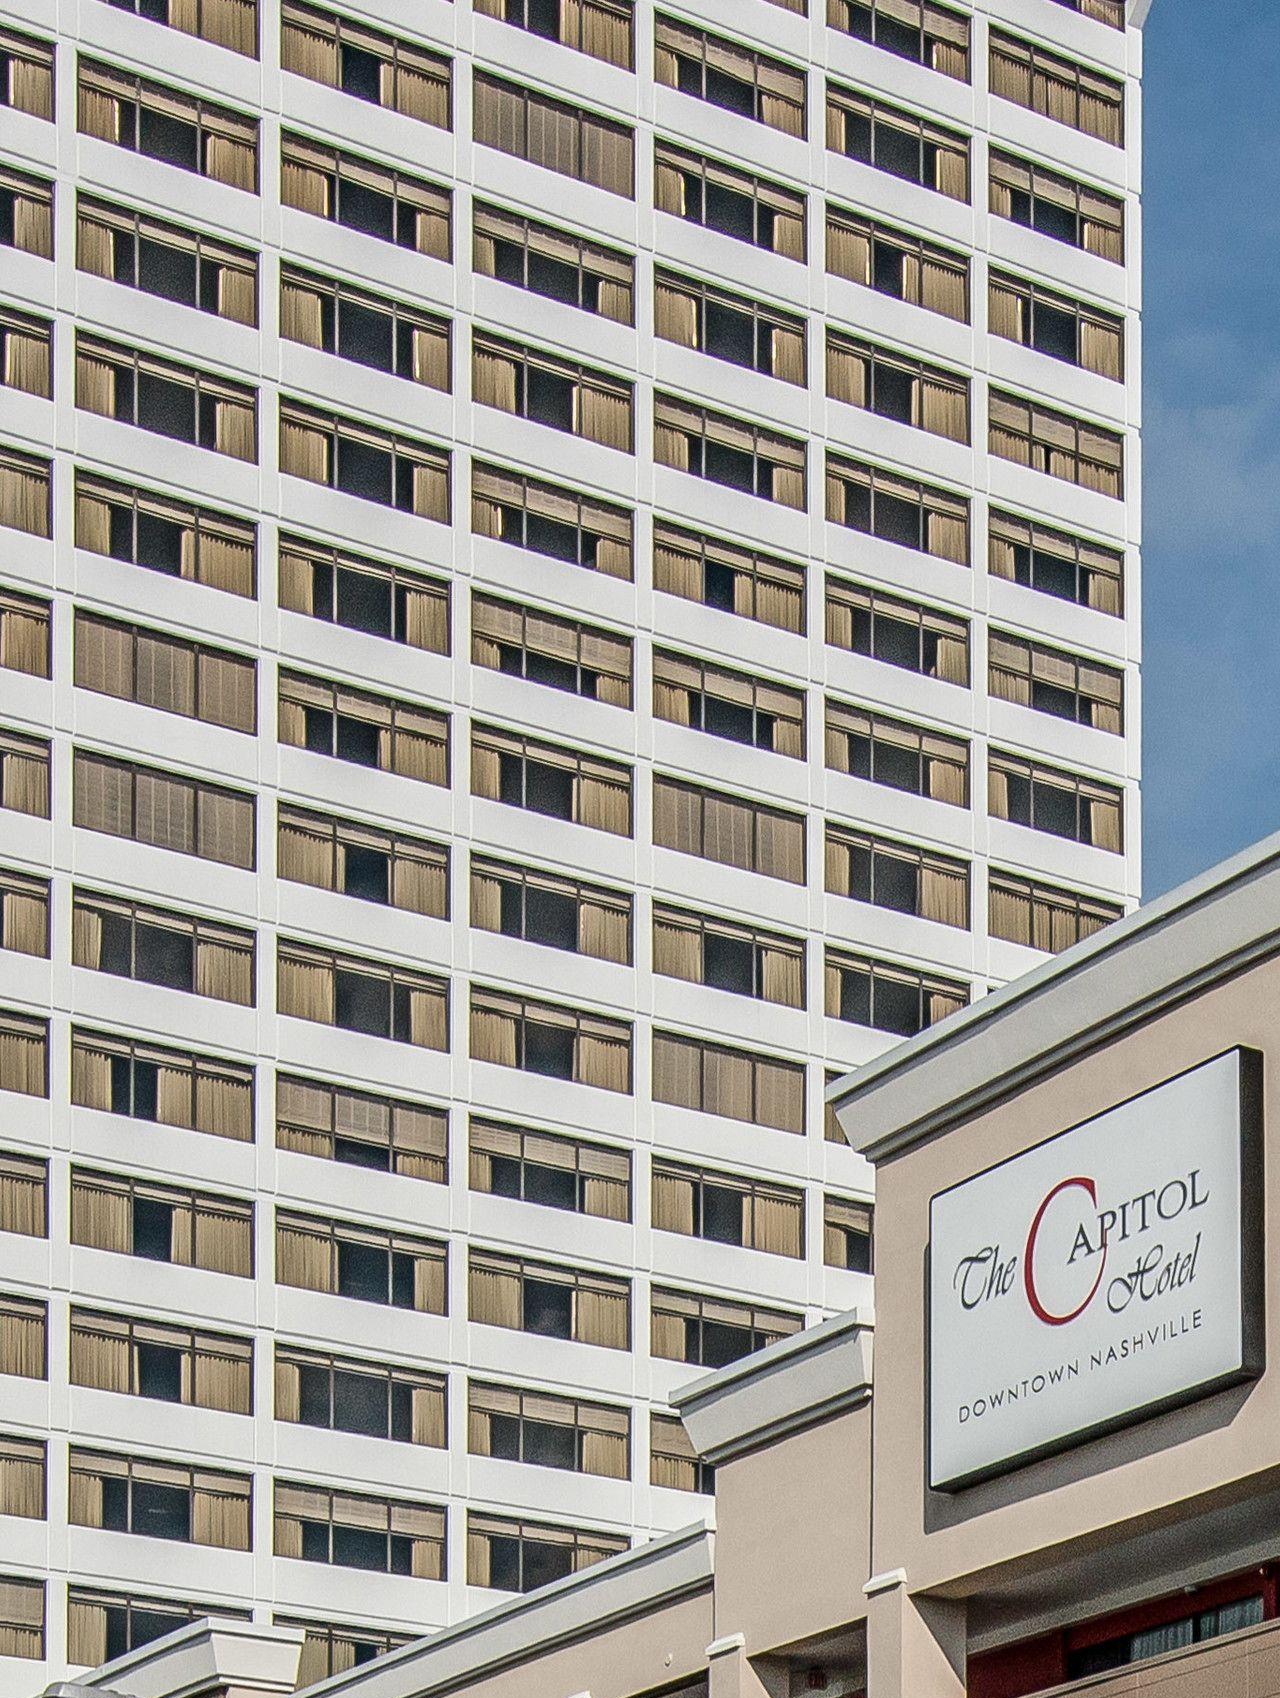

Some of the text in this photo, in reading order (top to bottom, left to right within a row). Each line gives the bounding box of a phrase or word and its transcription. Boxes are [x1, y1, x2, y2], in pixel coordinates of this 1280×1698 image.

[953, 1168, 1210, 1326] The CAPITOL
[1106, 1232, 1202, 1313] Hotel
[958, 1308, 1203, 1424] DOWNTOWN NASHVILLE
